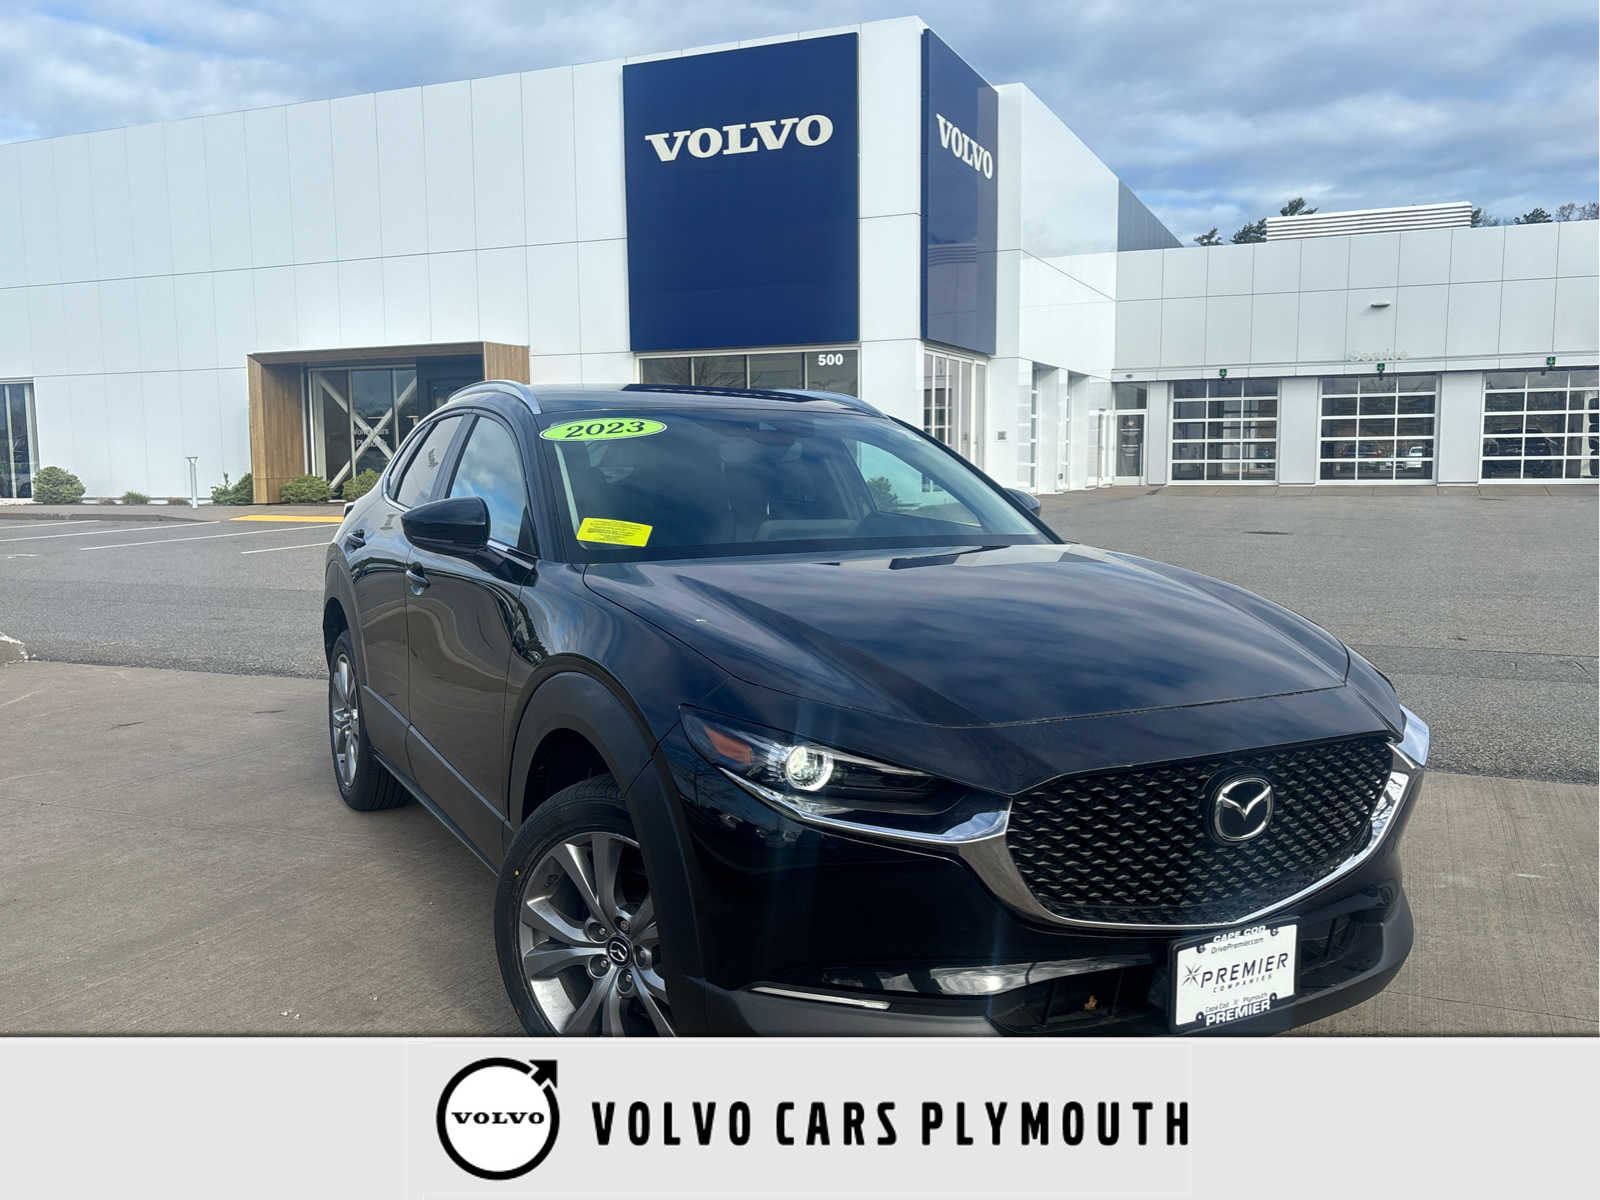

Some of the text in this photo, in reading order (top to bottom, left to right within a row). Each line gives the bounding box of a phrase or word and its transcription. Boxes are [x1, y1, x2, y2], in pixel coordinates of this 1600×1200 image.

[644, 114, 834, 162] VOLVO
[935, 113, 994, 180] VOLVO
[818, 353, 844, 367] 500
[564, 421, 646, 438] 2023
[1213, 925, 1266, 943] CAPE COD
[1200, 953, 1288, 988] PREMIER
[1213, 973, 1272, 993] COMPANIES
[1205, 999, 1271, 1026] PREMIER
